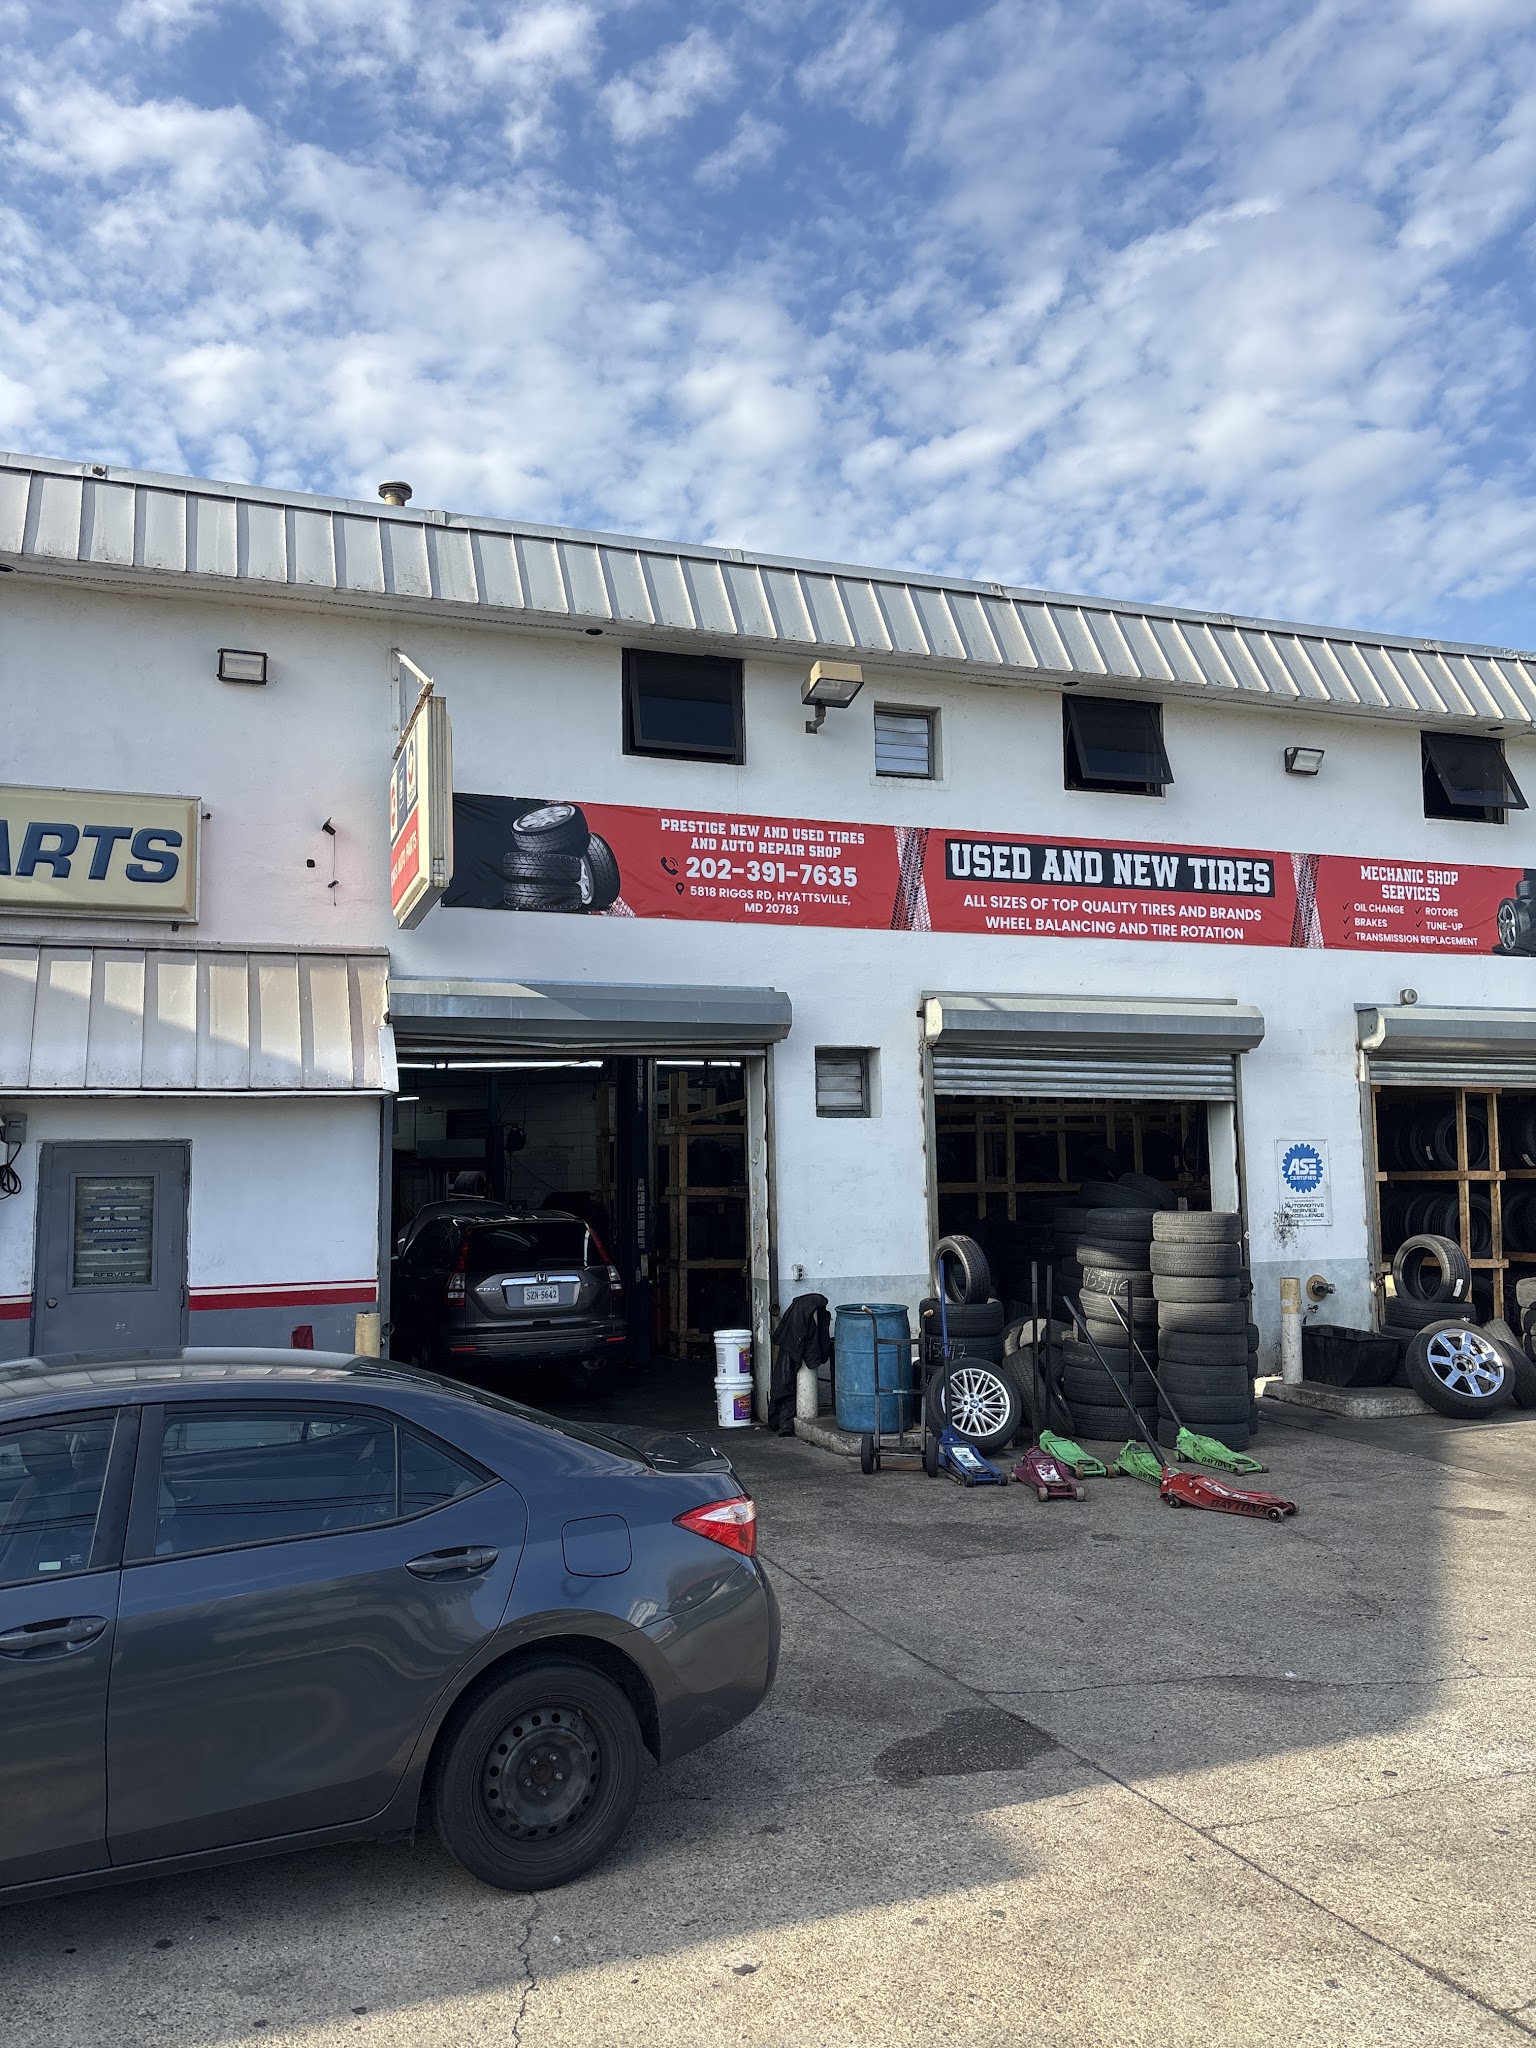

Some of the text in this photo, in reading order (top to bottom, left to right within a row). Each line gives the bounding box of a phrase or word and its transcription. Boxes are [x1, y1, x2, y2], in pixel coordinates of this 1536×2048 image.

[660, 818, 865, 844] PRESTIGE NEW AND USED TIRES
[0, 819, 183, 883] RTS
[691, 837, 841, 858] AND AUTO REPAIR SHOP
[686, 856, 858, 887] 202-391-7635
[950, 843, 1271, 894] USED AND NEW TIRES
[1360, 865, 1458, 885] MECHANIC SHOP
[690, 886, 852, 906] 5818 RIGGS RD, HYATTSVILLE,
[1381, 884, 1440, 902] SERVICES
[744, 902, 799, 915] MD 20783
[963, 894, 1262, 921] ALL SIZES OF TOP QUALITY TIRES AND BRANDS
[1354, 903, 1404, 914] OIL CHANGE
[1425, 907, 1459, 917] ROTORS
[985, 915, 1244, 939] WHEEL BALANCING AND TIRE ROTATION
[1354, 917, 1388, 928] BRAKES
[1426, 921, 1463, 931] TUNE-UP
[1355, 932, 1478, 946] TRANSMISSION REPLACEMENT
[1288, 1158, 1317, 1175] ASE
[1202, 1456, 1232, 1469] DAYTONA
[1209, 1500, 1267, 1514] DAYTONA
